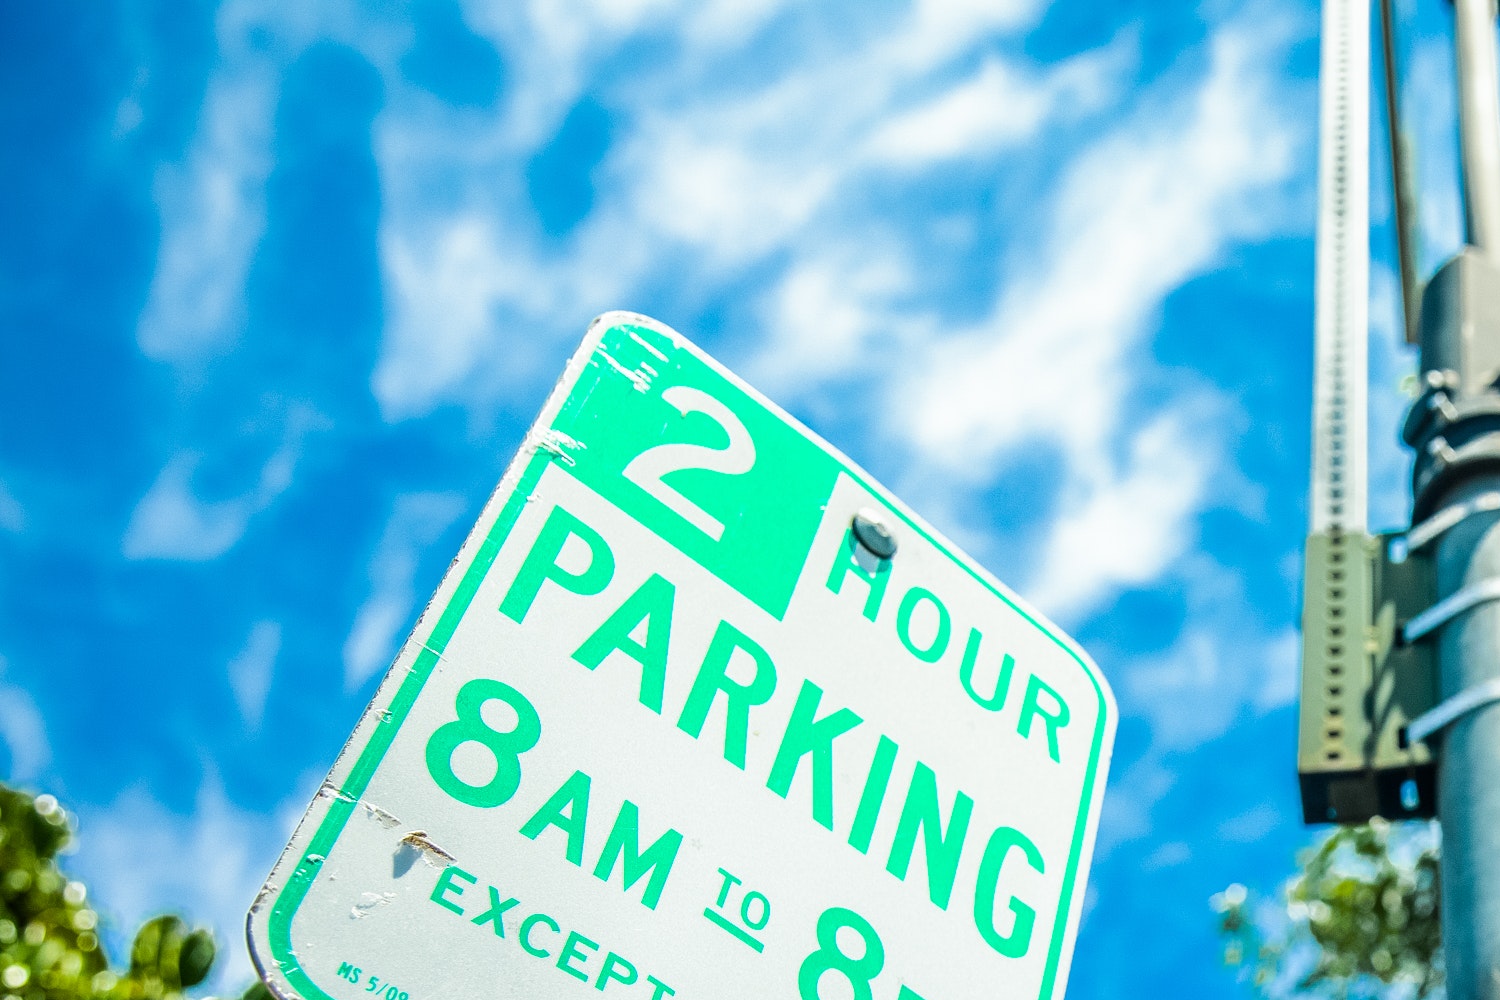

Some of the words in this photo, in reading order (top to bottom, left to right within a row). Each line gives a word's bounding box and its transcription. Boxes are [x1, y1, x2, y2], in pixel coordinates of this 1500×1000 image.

[620, 386, 757, 542] 2
[825, 520, 1071, 765] HOUR
[498, 504, 1045, 959] PARKING
[336, 960, 363, 985] MS
[716, 866, 770, 932] TO
